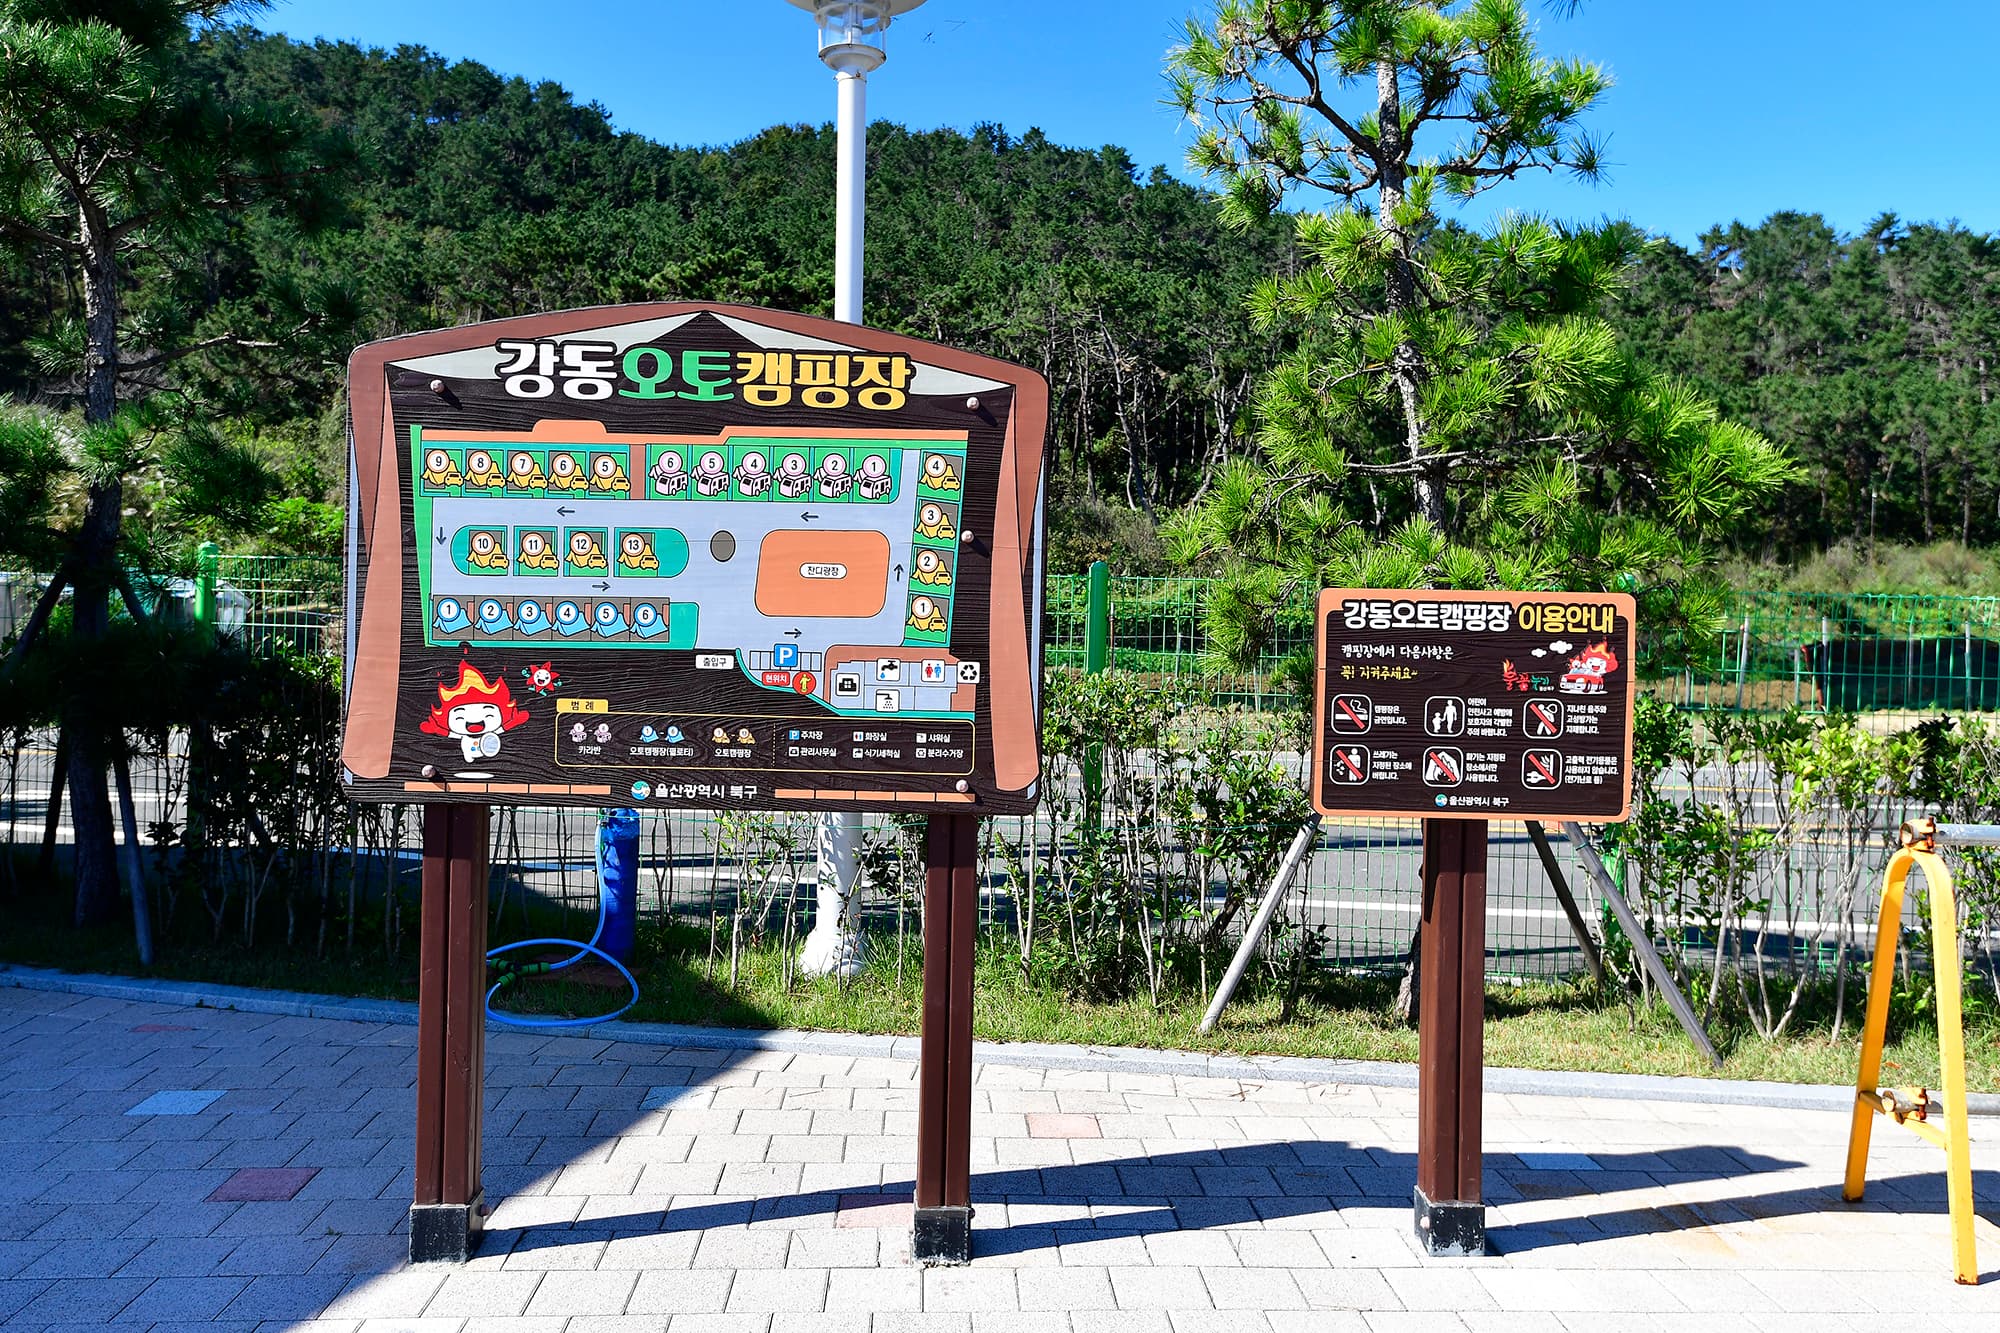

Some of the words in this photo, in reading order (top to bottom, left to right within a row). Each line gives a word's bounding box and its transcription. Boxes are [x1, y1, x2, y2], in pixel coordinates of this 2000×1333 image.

[499, 342, 911, 411] 강동오토캠핑장
[436, 456, 443, 467] 9
[478, 458, 485, 468] 8
[520, 459, 526, 469] 7
[560, 460, 567, 470] 6
[668, 458, 674, 468] 6
[709, 458, 716, 468] 5
[751, 459, 758, 469] 4
[792, 460, 798, 470] 3
[832, 460, 839, 470] 2
[933, 461, 940, 470] 4
[602, 462, 609, 472] 5
[871, 462, 876, 472] 1
[928, 510, 935, 520] 3
[478, 538, 489, 549] 10
[528, 540, 538, 550] 11
[576, 539, 586, 549] 12
[629, 540, 639, 550] 13
[924, 556, 931, 566] 2
[807, 565, 839, 577] 잔디광장
[446, 605, 451, 615] 1
[487, 606, 494, 616] 2
[526, 607, 533, 617] 3
[563, 607, 571, 618] 4
[921, 603, 925, 612] 1
[602, 608, 609, 619] 5
[642, 610, 649, 620] 6
[1343, 602, 1512, 632] 강동오토캠핑장
[1519, 605, 1614, 634] 이용안내
[779, 647, 793, 664] P
[1341, 644, 1395, 659] 캠핑장에서
[1400, 645, 1454, 660] 다음사항은
[703, 657, 727, 668] 출입구
[1340, 665, 1355, 680] 꼭!
[765, 674, 787, 684] 현위치
[1374, 716, 1407, 725] 금연입니다.
[1467, 718, 1492, 727] 보호자의
[801, 731, 823, 740] 주차장
[865, 732, 887, 742] 화장실
[1467, 727, 1480, 737] 주의
[928, 734, 950, 743] 샤워실
[578, 746, 601, 755] 카라반
[714, 748, 752, 758] 오토캠핑장
[800, 747, 837, 757] 관리사무실
[864, 749, 900, 759] 식기세척실
[927, 749, 964, 758] 분리수거장
[1373, 750, 1398, 759] 쓰레기는
[655, 784, 725, 799] 울산광역시
[730, 785, 758, 799] 북구
[1449, 796, 1490, 807] 울산광역시
[1492, 797, 1510, 807] 북구
